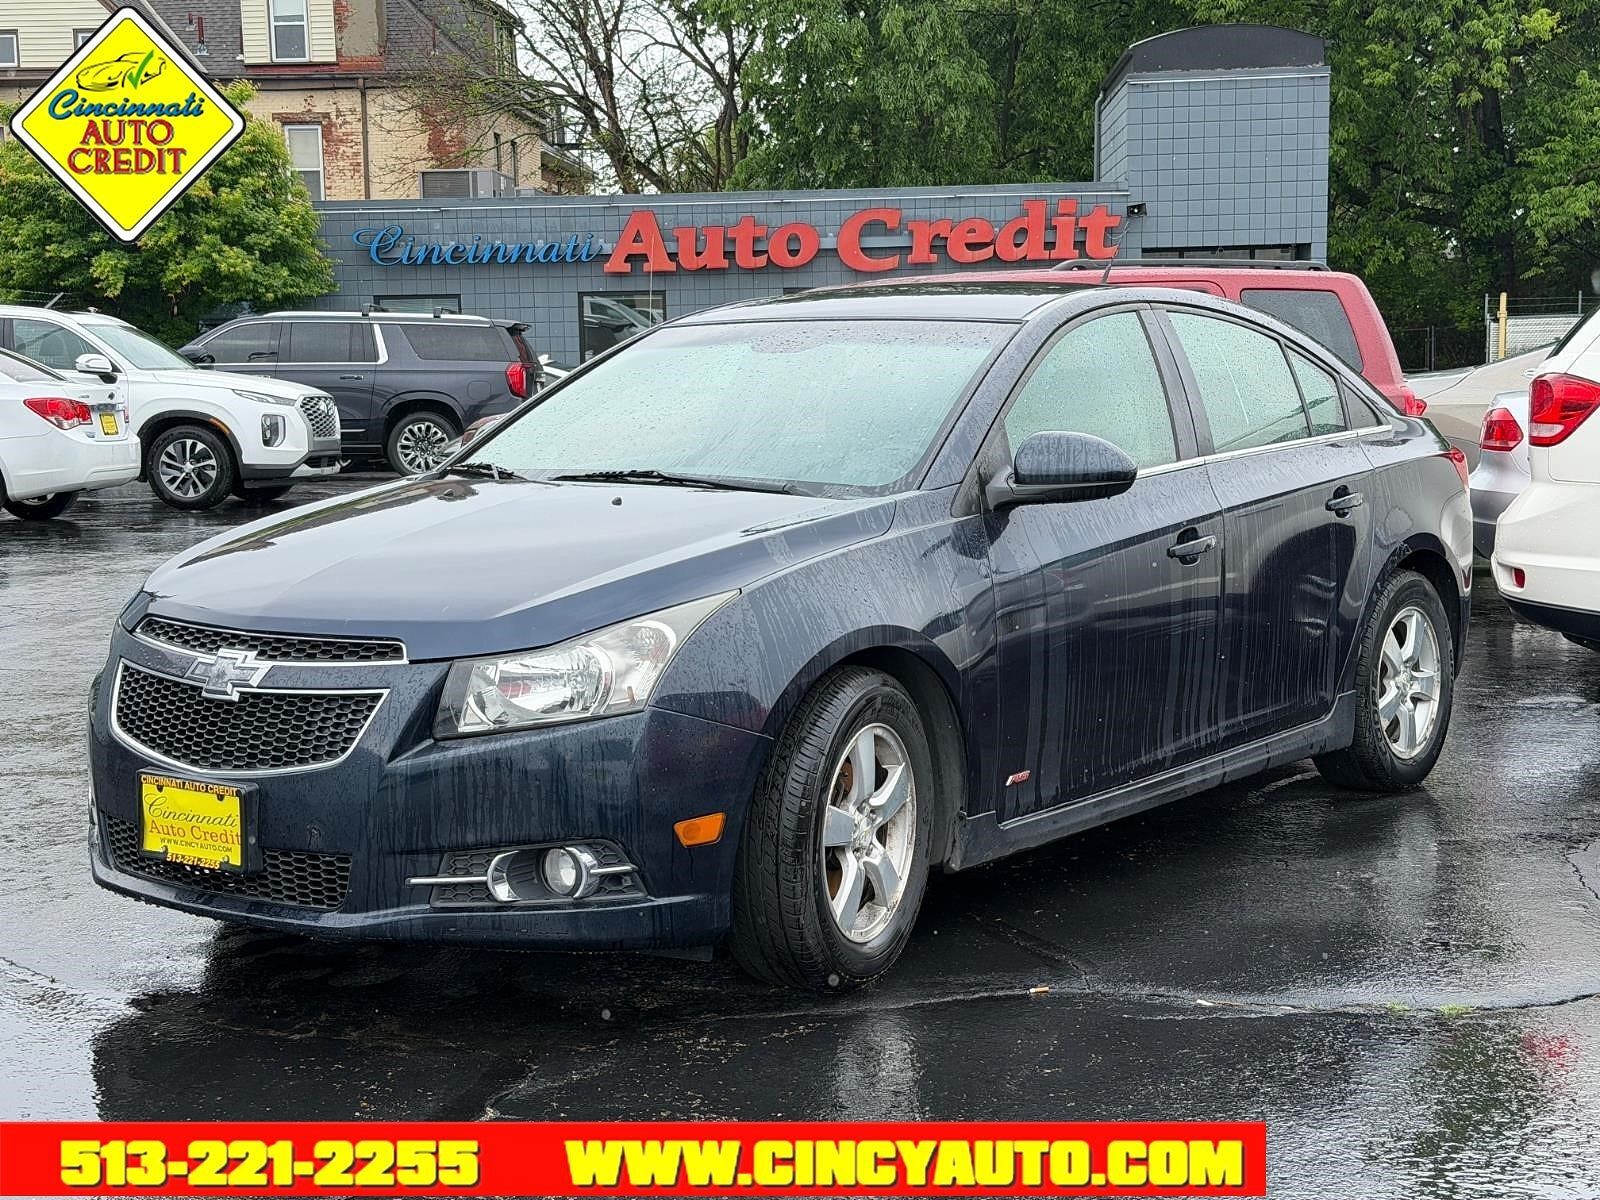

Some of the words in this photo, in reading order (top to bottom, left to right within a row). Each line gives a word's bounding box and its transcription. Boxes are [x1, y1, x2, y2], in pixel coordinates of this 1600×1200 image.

[352, 224, 604, 266] Cincinnati
[604, 209, 820, 274] Auto
[836, 199, 1122, 273] Credit
[141, 775, 184, 789] CINCINNATI
[185, 781, 207, 793] AUTO
[207, 784, 238, 796] CREDIT
[144, 793, 239, 828] Cincinnati
[149, 819, 186, 838] Auto
[190, 825, 241, 845] Credit
[160, 837, 233, 853] WWW.CINCYAUTO.COM
[166, 853, 220, 869] 513-221-2255
